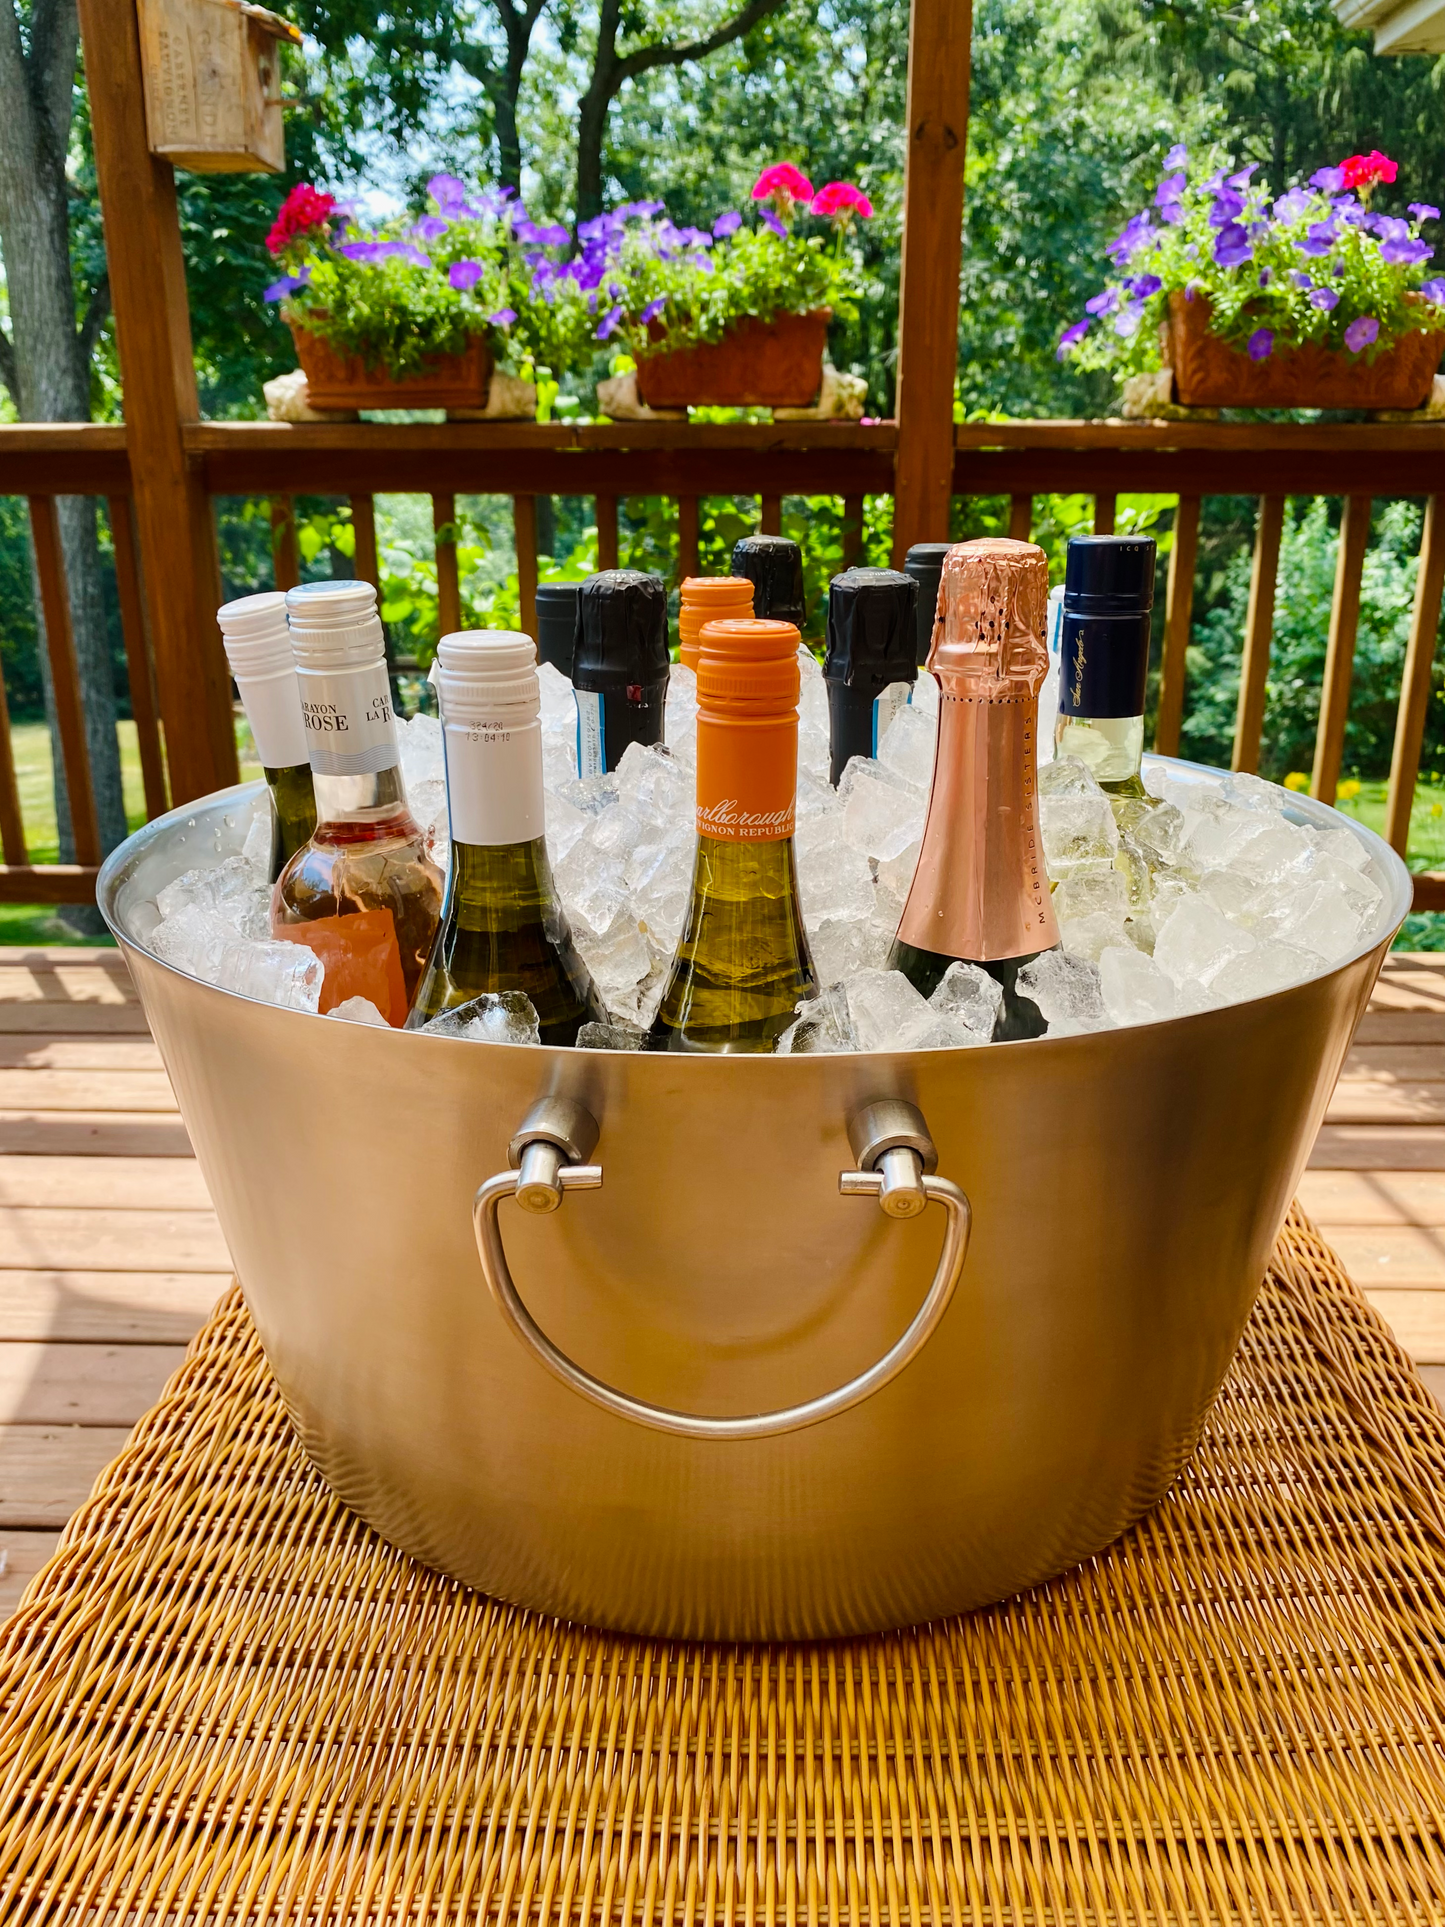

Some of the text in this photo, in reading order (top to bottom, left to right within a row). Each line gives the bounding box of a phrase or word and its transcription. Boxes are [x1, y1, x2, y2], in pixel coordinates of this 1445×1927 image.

[159, 31, 178, 136] SAUVIGNON
[172, 36, 190, 127] CABERNET
[1070, 629, 1087, 707] San Angelo
[304, 712, 349, 732] ROSE
[366, 711, 380, 721] LA
[465, 731, 511, 742] 13:04:10
[1024, 716, 1046, 924] MCBRIDE SISTERS
